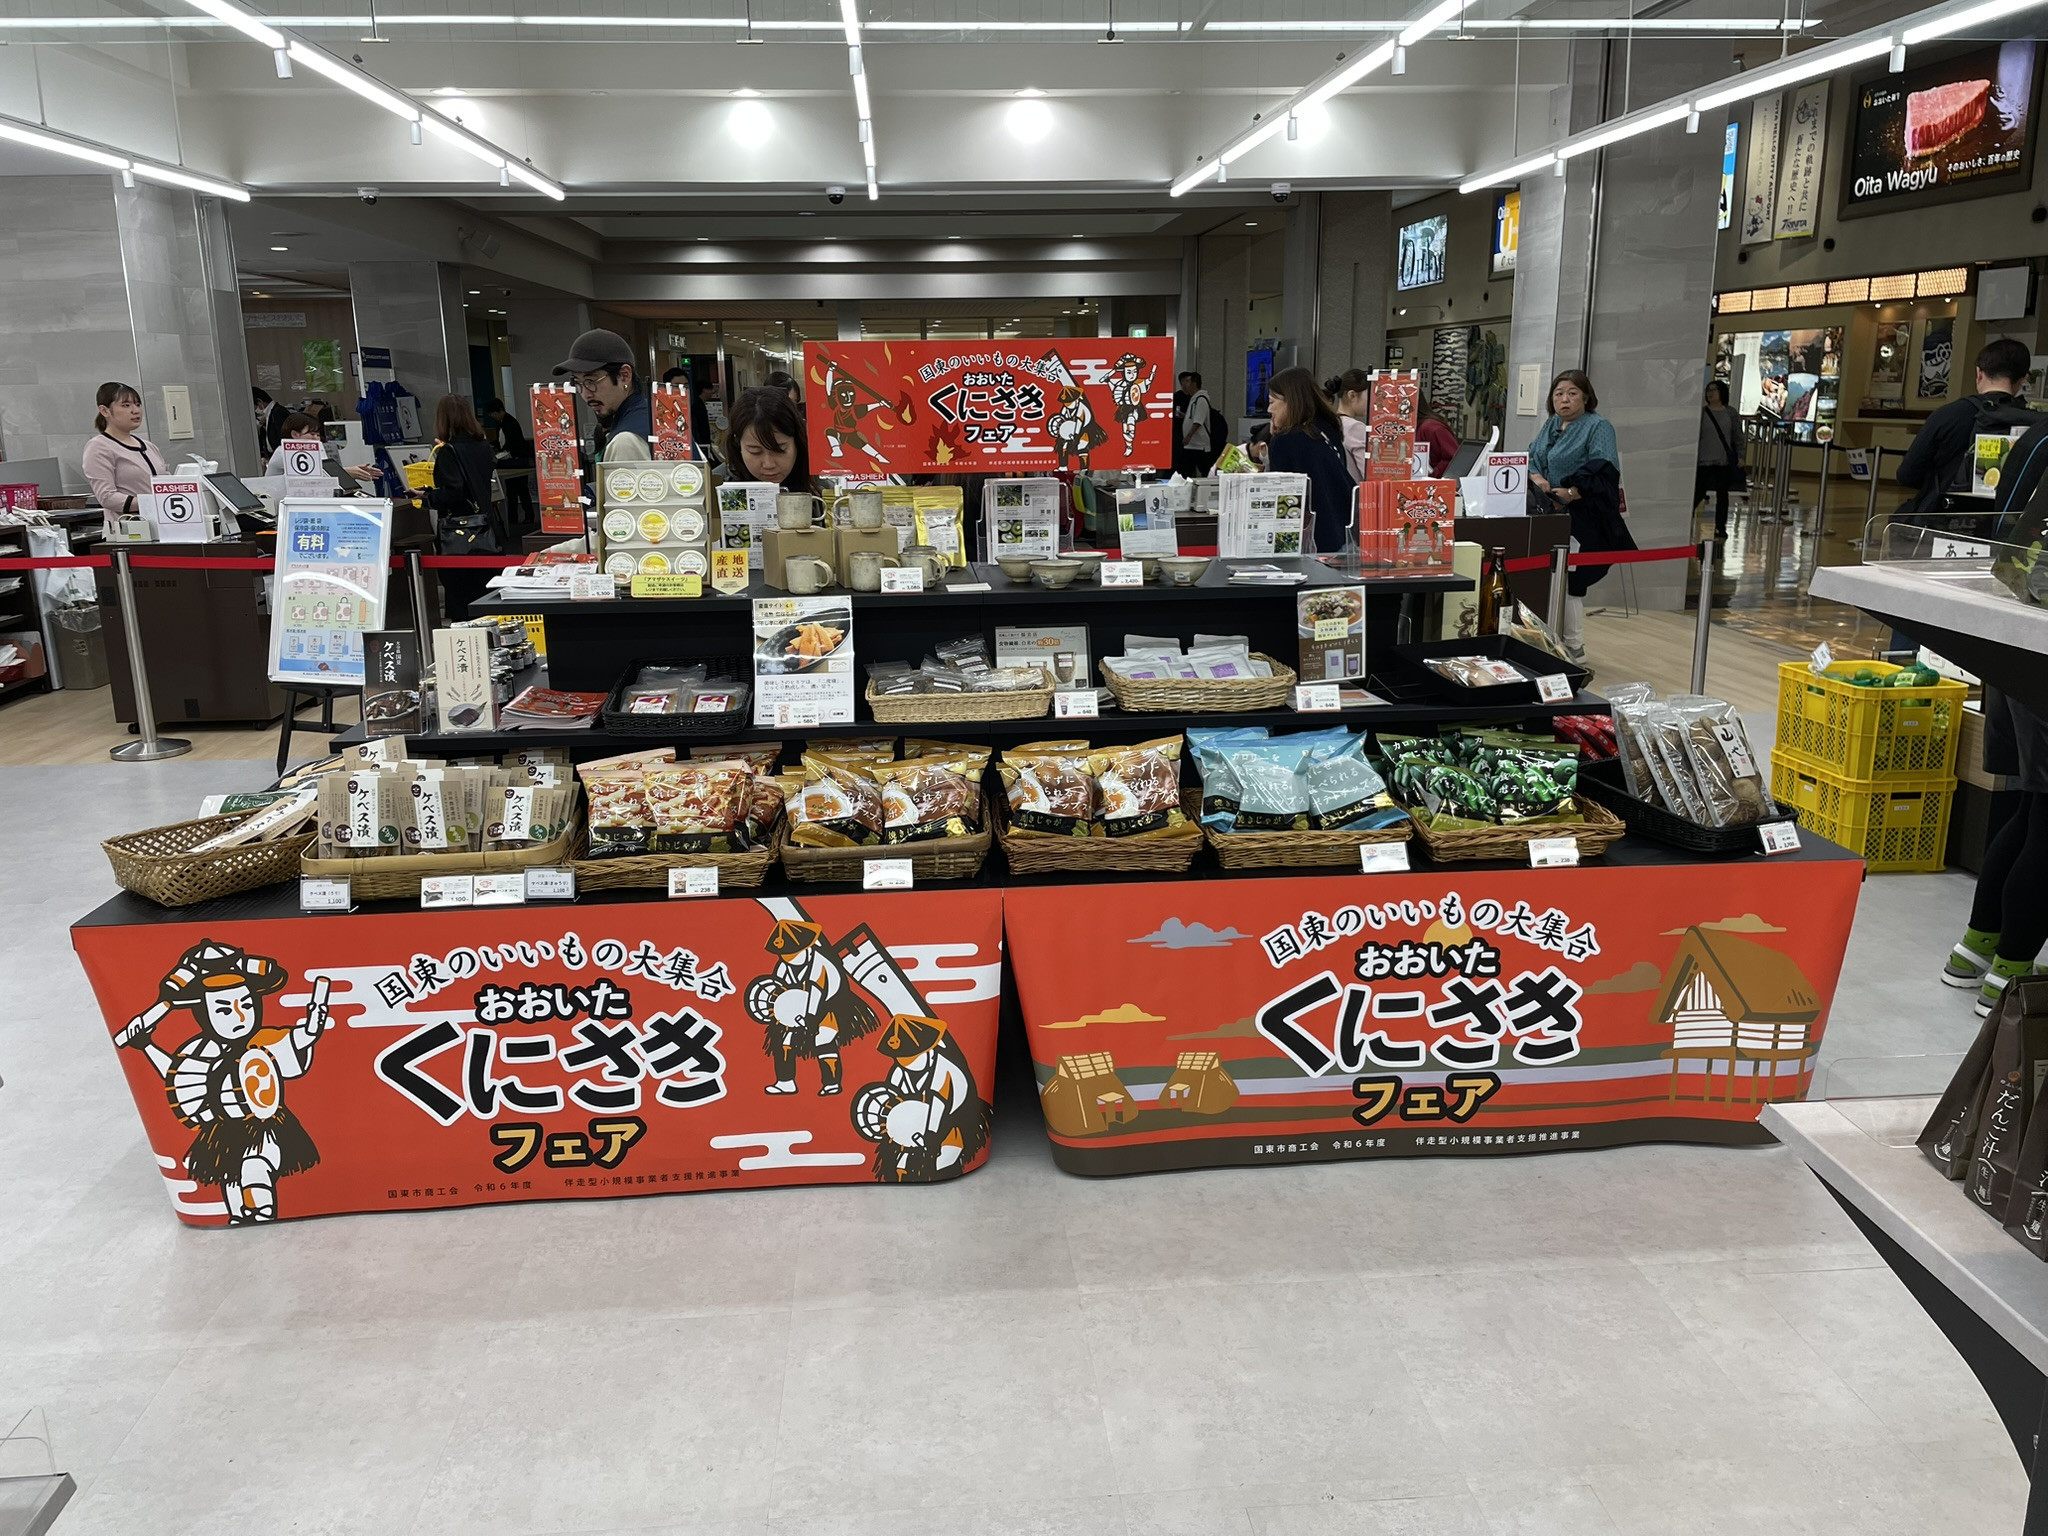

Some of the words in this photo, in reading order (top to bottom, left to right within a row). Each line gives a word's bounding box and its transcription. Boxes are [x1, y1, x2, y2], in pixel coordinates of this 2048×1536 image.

[1855, 176, 1882, 197] Oita
[1887, 167, 1938, 190] Wagyu
[919, 351, 1061, 382] 国東のいいもの大集合
[963, 373, 1014, 386] おおいた
[929, 384, 1044, 422] くにさき
[965, 425, 1015, 442] フェア
[296, 454, 308, 472] 6
[1491, 457, 1525, 466] CASHIER
[155, 484, 195, 493] CASHIER
[1501, 469, 1510, 489] 1
[170, 497, 186, 519] 5
[297, 533, 325, 551] 有料
[716, 554, 744, 566] 産地
[716, 567, 744, 578] 直送
[456, 639, 469, 673] ケベス漬
[357, 788, 371, 838] ケベス漬
[422, 791, 440, 840] ケベス漬
[508, 794, 525, 832] ケベス漬
[1266, 894, 1597, 963] 国東のいいもの大集合
[374, 933, 733, 1009] 国東のいいもの大集合
[1358, 940, 1499, 976] おおいた
[478, 981, 629, 1022] おおいた
[1259, 969, 1580, 1074] くにさき
[378, 1009, 722, 1124] くにさき
[1357, 1077, 1495, 1121] フェア
[496, 1122, 641, 1168] フェア
[1254, 1142, 1319, 1154] 国東市商工会
[1332, 1138, 1386, 1150] 令和6年度
[1415, 1130, 1581, 1146] 伴走型小規模事業者支援推進事業
[388, 1186, 459, 1199] 国東市商工会
[474, 1181, 532, 1192] 令和6年度
[564, 1170, 740, 1187] 伴走型小規模事業者支援推進事業
